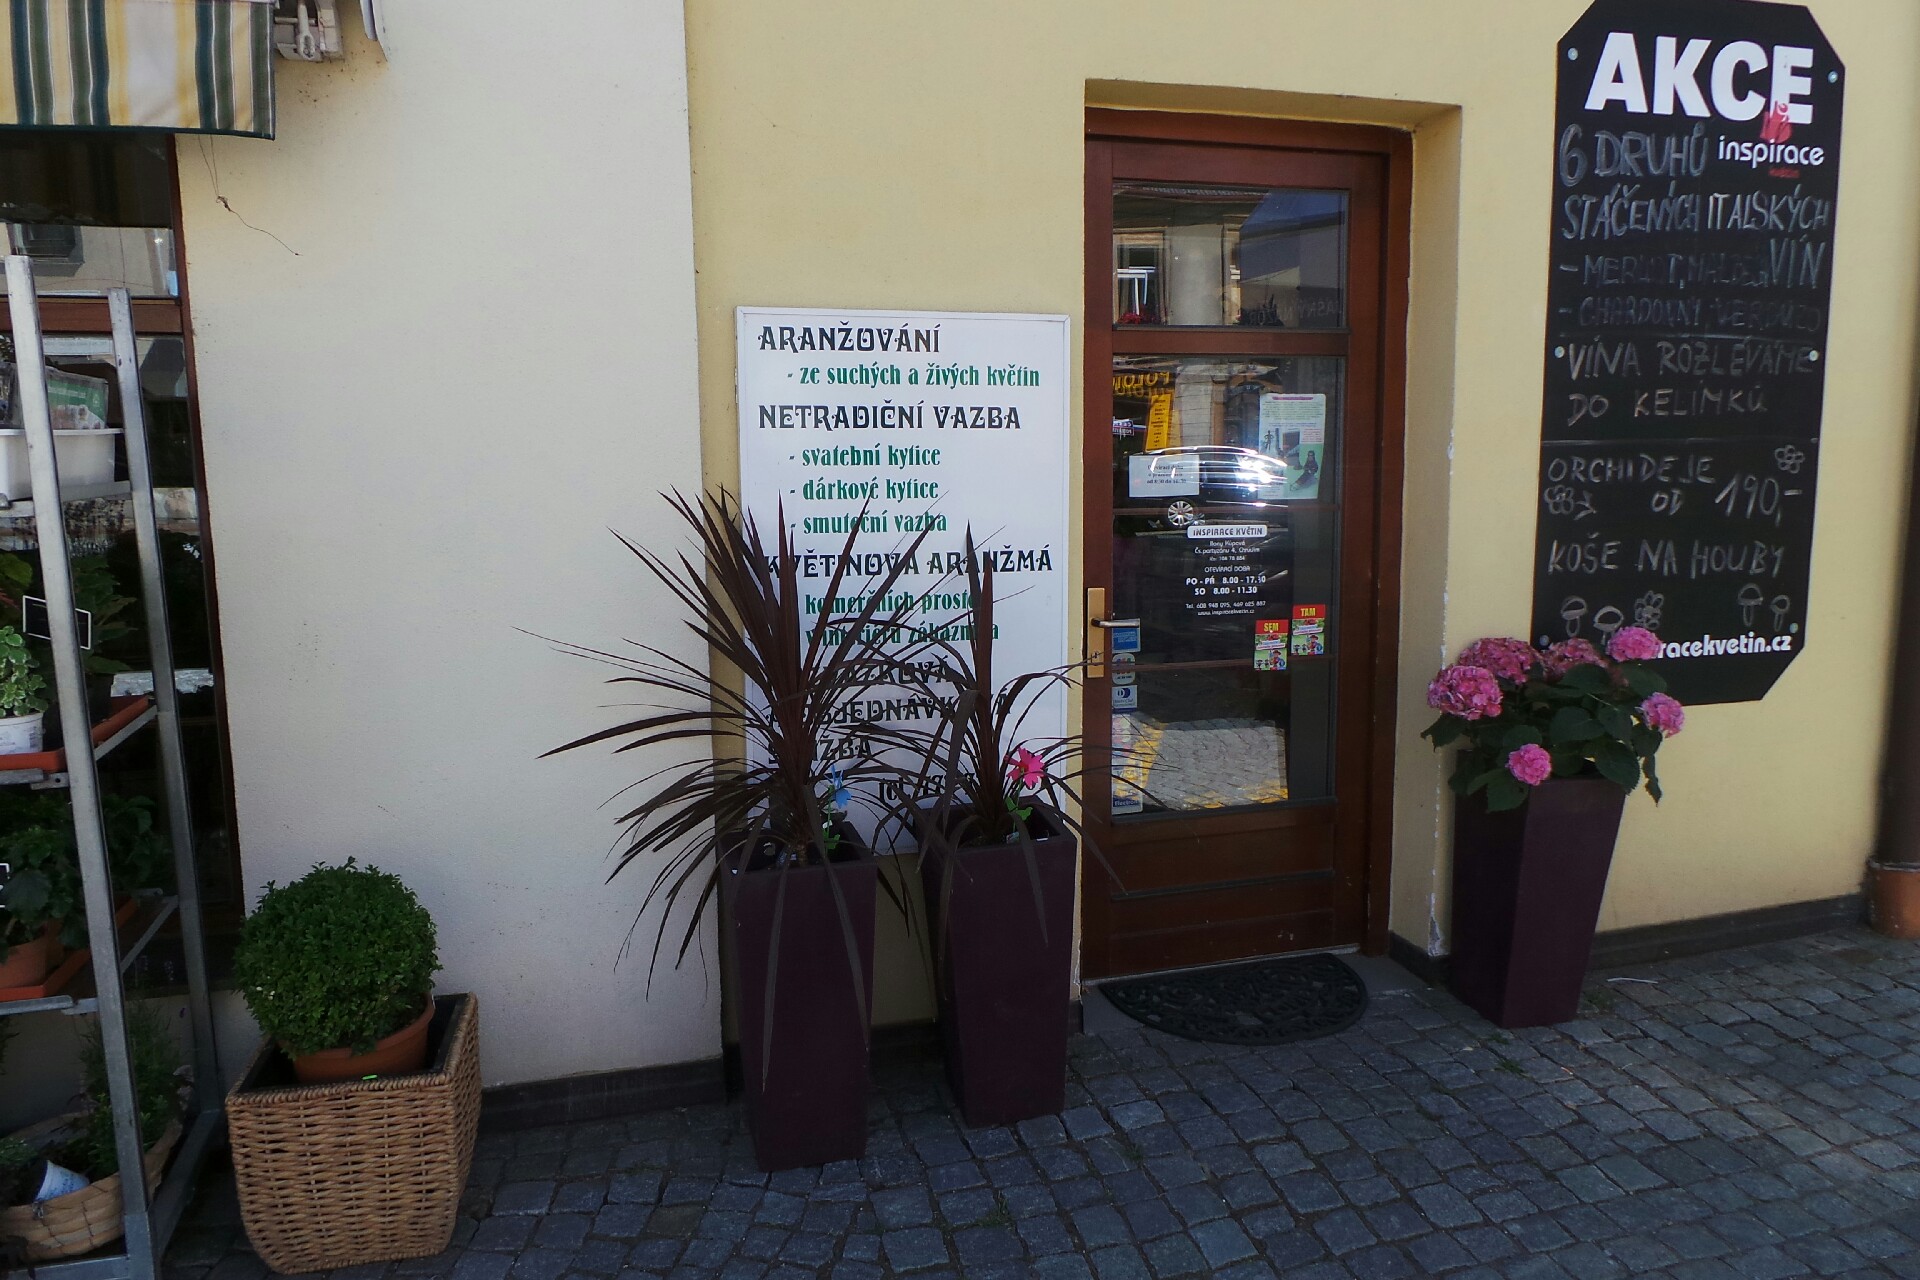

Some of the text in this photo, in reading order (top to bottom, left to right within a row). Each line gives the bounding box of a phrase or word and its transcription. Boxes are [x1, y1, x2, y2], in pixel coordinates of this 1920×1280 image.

[1585, 32, 1814, 124] AKCE
[1559, 121, 1709, 187] 6 DRUHŮ
[1719, 135, 1825, 168] inspirace
[1562, 180, 1829, 240] STÁČENÝCH ITALSKÝCH
[758, 320, 941, 353] ARANŽOVÁNÍ
[1568, 335, 1641, 381] VÍNA
[799, 367, 820, 385] ze
[827, 361, 901, 389] suchých
[908, 368, 919, 385] a
[925, 362, 980, 389] živých
[986, 363, 1040, 387] květin
[758, 399, 1021, 432] NETRADIČNÍ VAZBA
[1568, 393, 1609, 427] DO
[802, 442, 881, 467] svatební
[888, 445, 941, 469] kytice
[802, 476, 880, 500] dárkové
[886, 478, 939, 503] kytice
[1652, 489, 1685, 515] OD
[803, 510, 888, 534] smuteční
[894, 511, 947, 533] vazba
[1193, 526, 1263, 537] INSPIRACE KVĚTIN
[926, 544, 1053, 576] ARANŽMÁ
[1548, 532, 1785, 580] KOŠE NA HOUBY
[1186, 577, 1198, 586] PO
[1204, 575, 1215, 585] PÁ
[1194, 588, 1206, 596] SO
[1213, 587, 1230, 595] 8.00
[1264, 622, 1279, 632] SEM
[1300, 608, 1316, 617] TAM
